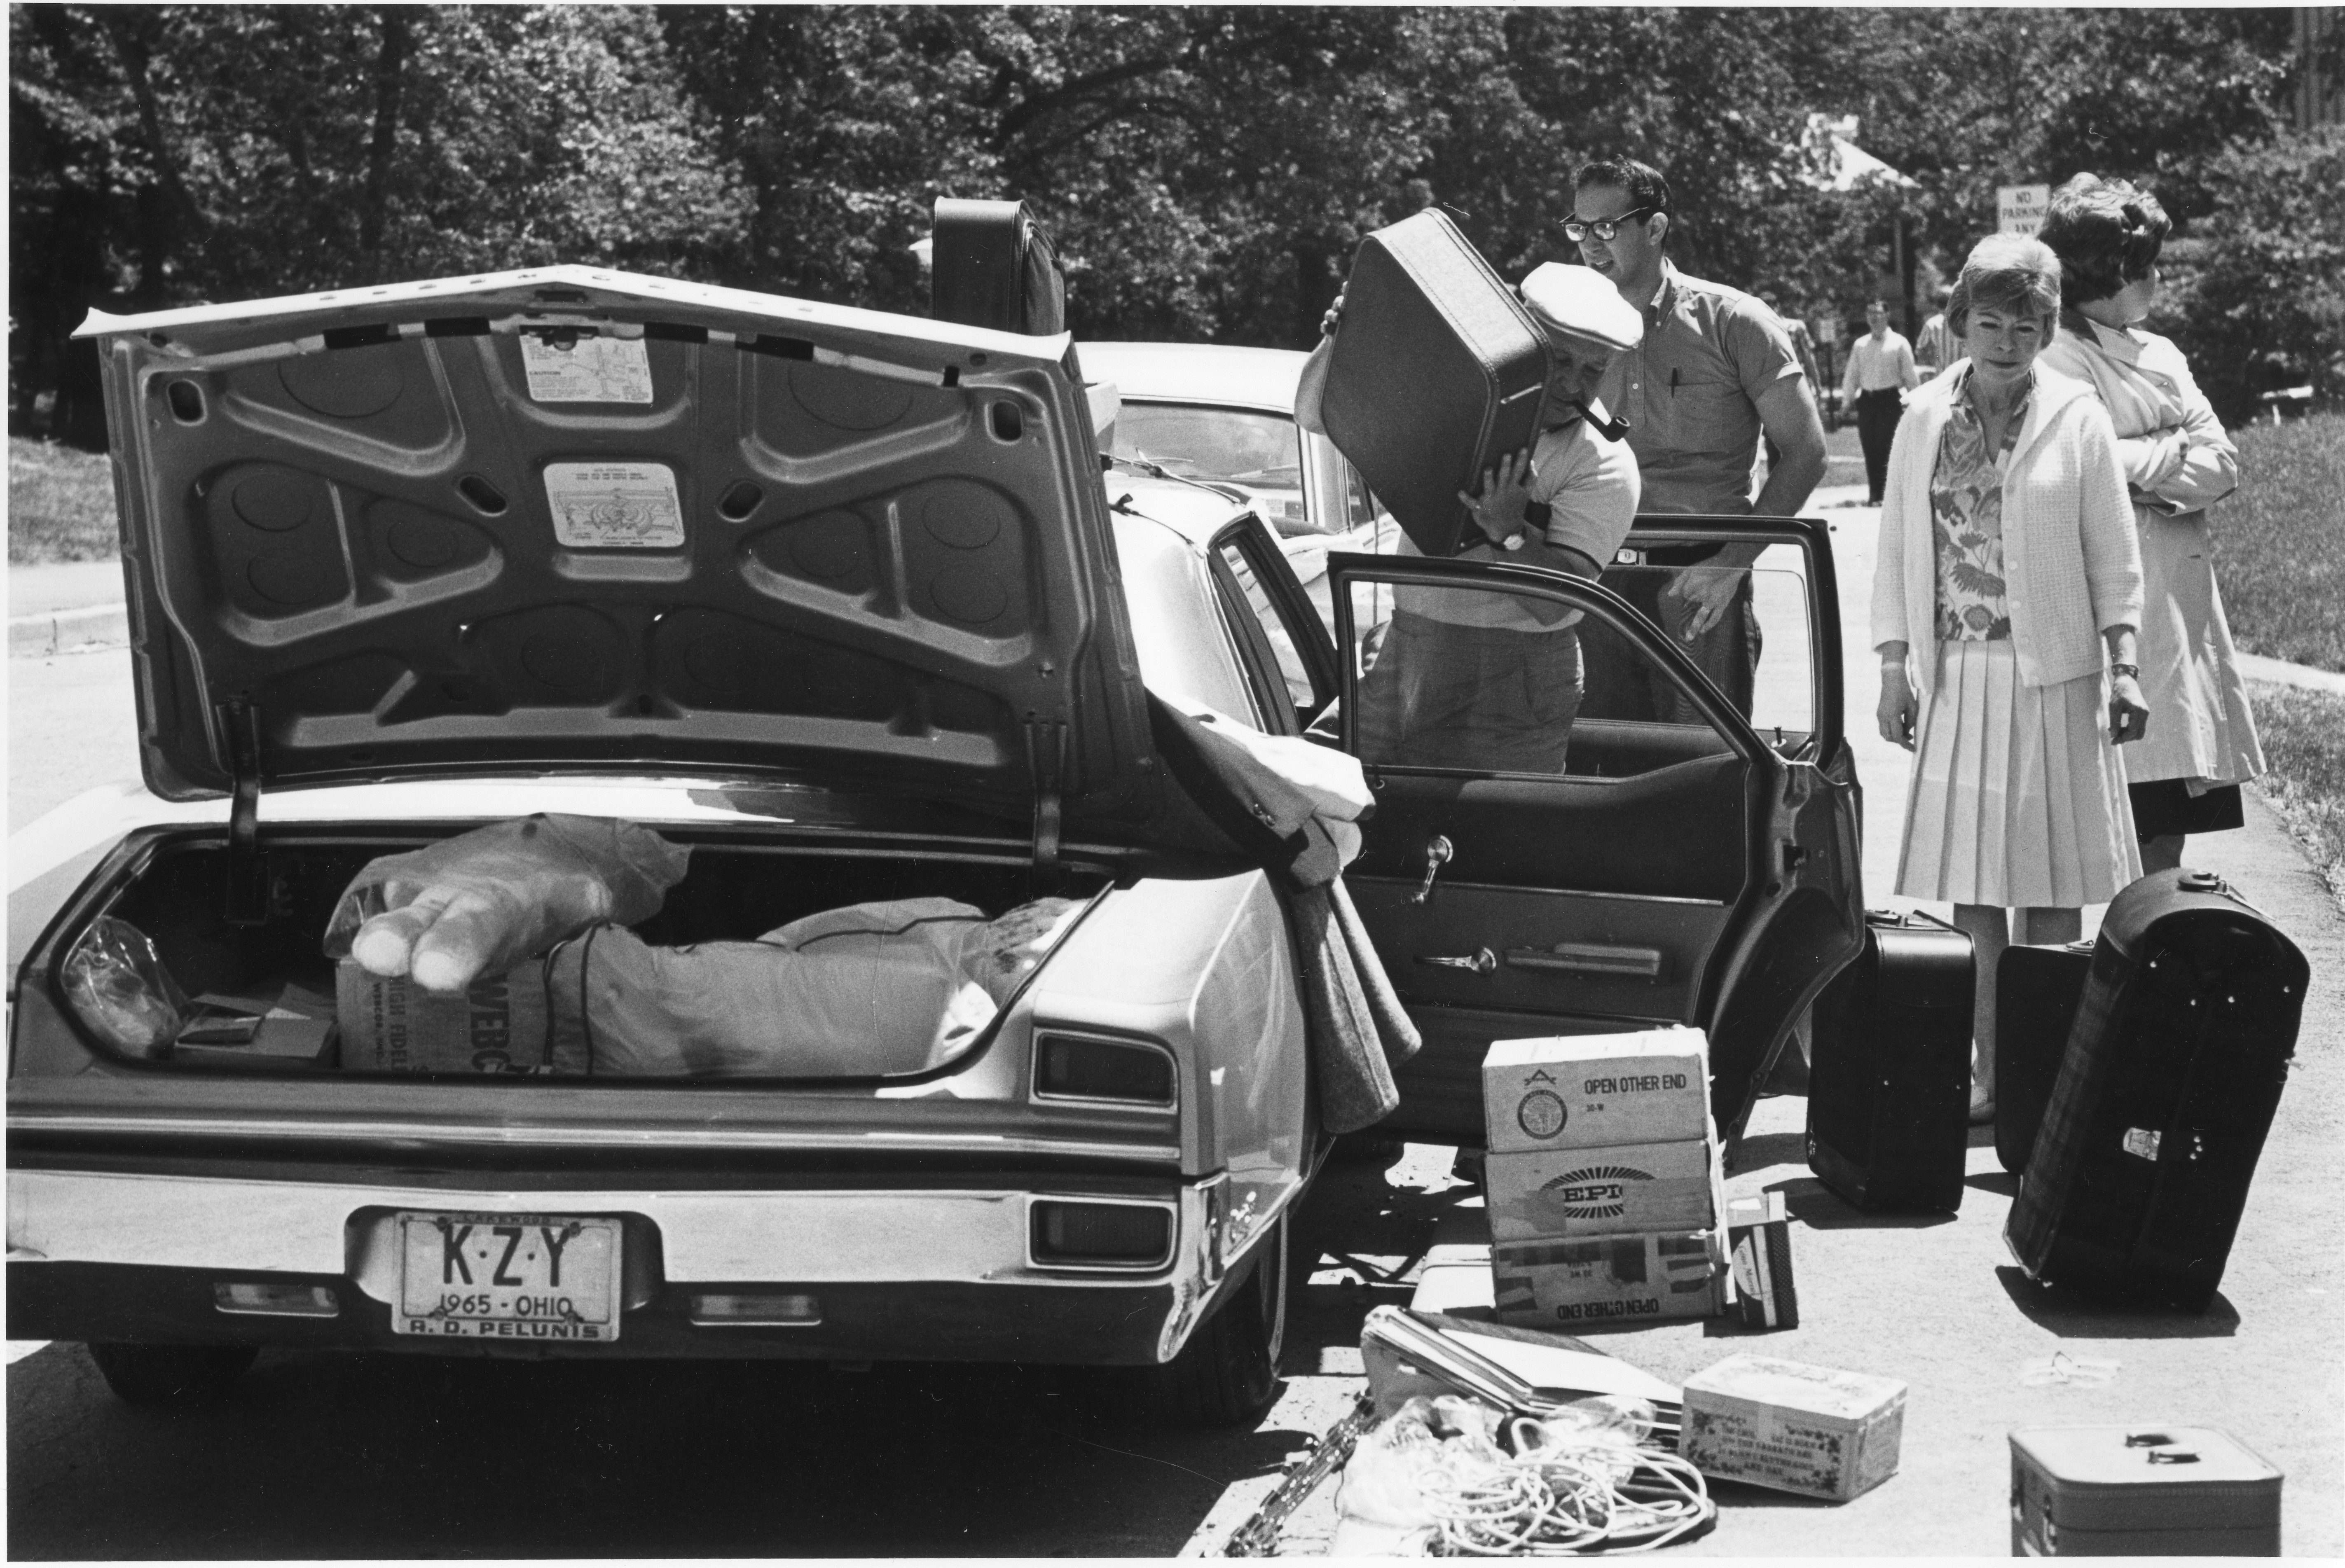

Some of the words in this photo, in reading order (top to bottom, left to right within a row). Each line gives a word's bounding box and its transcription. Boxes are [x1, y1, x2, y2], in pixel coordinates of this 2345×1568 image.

[2016, 192, 2031, 203] NO
[2003, 207, 2045, 219] PARKING
[1585, 1078, 1617, 1094] OPEN
[1620, 1075, 1659, 1092] OTHER
[1662, 1074, 1686, 1089] END
[440, 1294, 491, 1314] 1965
[515, 1295, 573, 1317] OHIO
[1557, 1304, 1582, 1319] END
[1626, 1298, 1659, 1314] OPEN
[410, 1320, 433, 1333] A.
[444, 1321, 468, 1334] D.
[480, 1321, 599, 1338] PELUNIS
